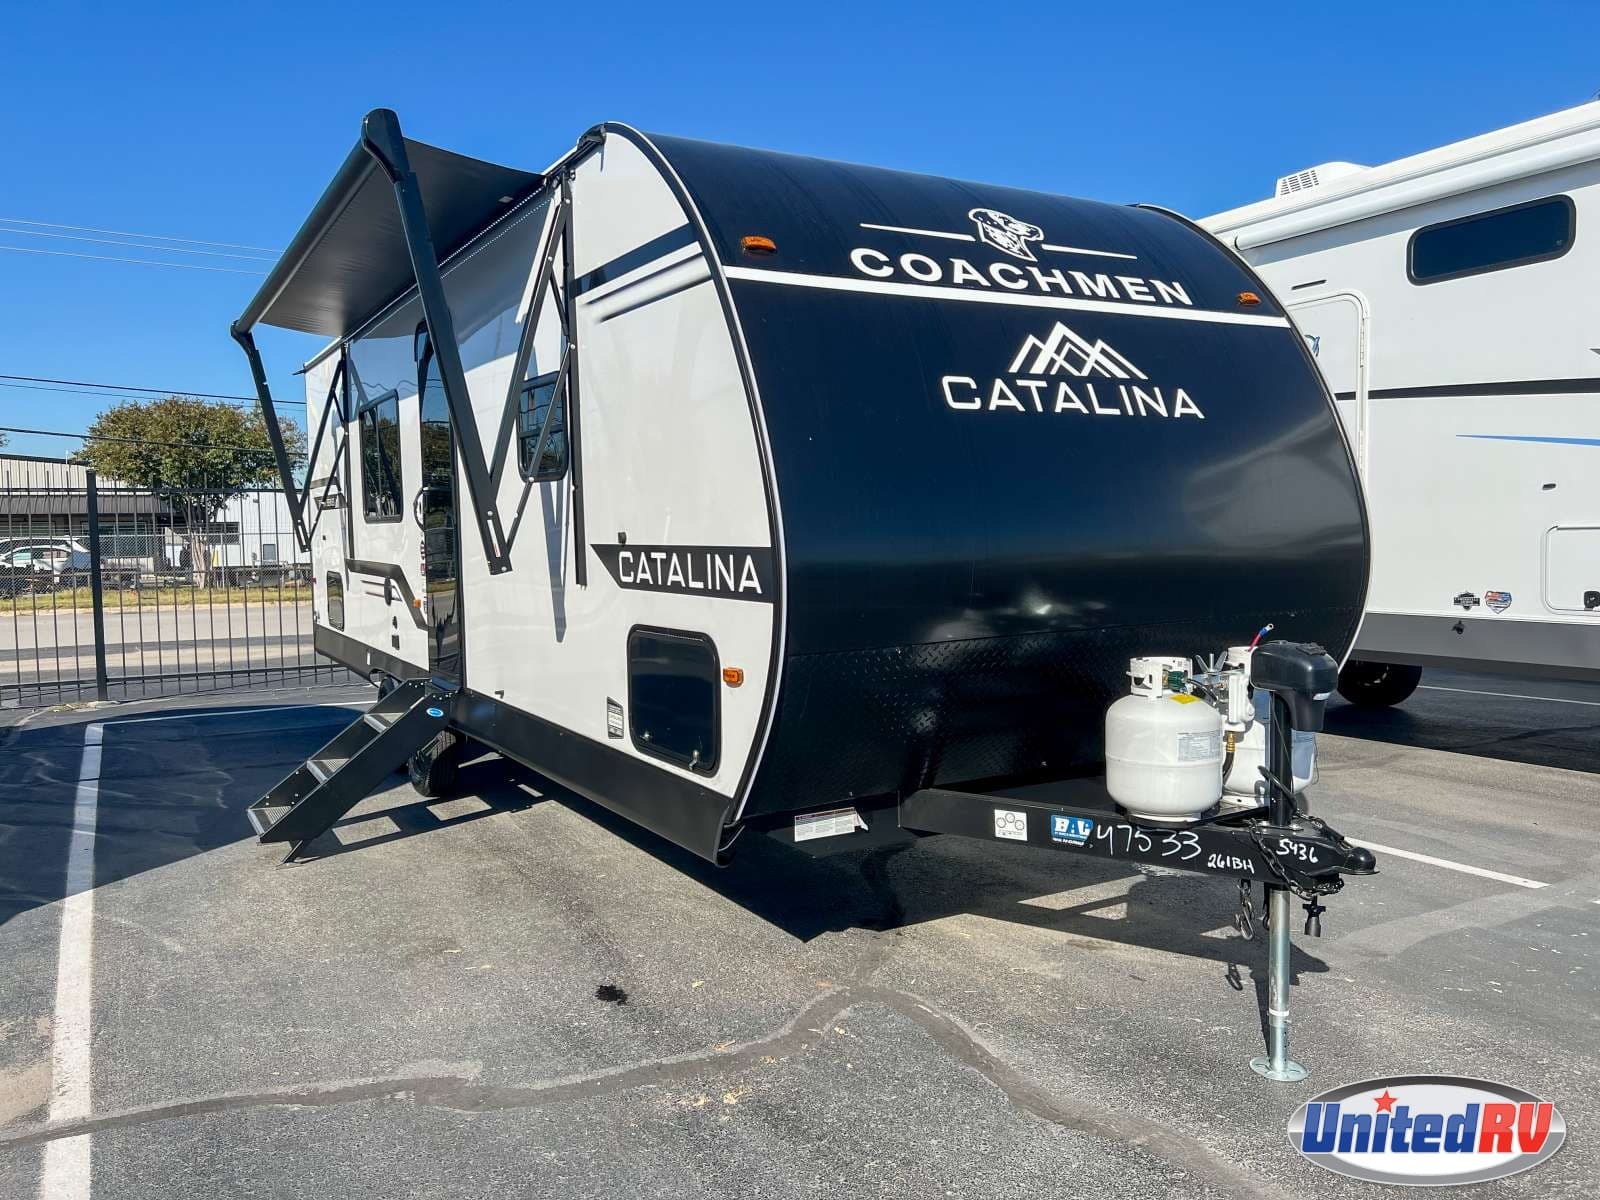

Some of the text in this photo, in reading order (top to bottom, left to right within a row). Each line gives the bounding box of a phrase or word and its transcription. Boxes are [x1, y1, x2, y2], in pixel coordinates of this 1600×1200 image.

[849, 246, 1193, 307] COACHMEN
[941, 374, 1206, 419] CATALINA
[618, 550, 763, 595] CATALINA
[1276, 838, 1319, 864] 5436
